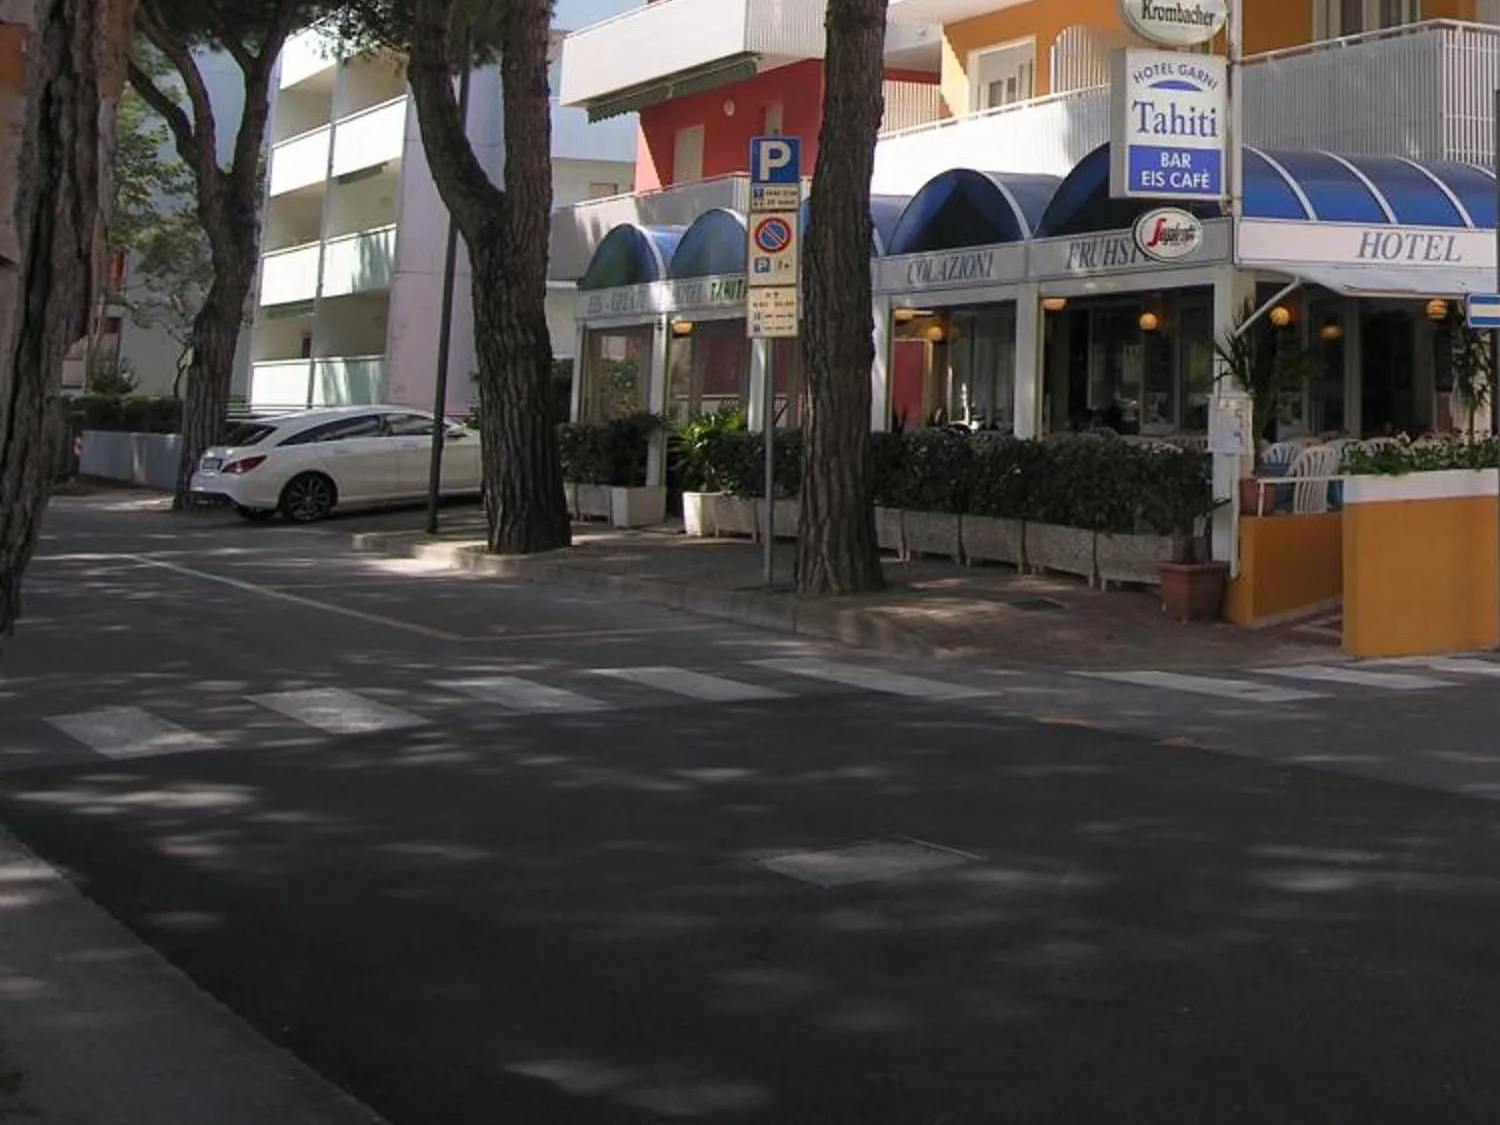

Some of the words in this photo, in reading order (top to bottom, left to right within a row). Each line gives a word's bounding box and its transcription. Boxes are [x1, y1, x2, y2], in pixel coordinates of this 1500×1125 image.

[1133, 62, 1174, 83] HOTEL
[1178, 63, 1218, 91] GARNI
[1132, 99, 1217, 137] Tahiti
[760, 140, 791, 181] P
[1160, 151, 1191, 168] BAR
[1141, 170, 1165, 187] EIS
[1358, 230, 1462, 262] HOTEL
